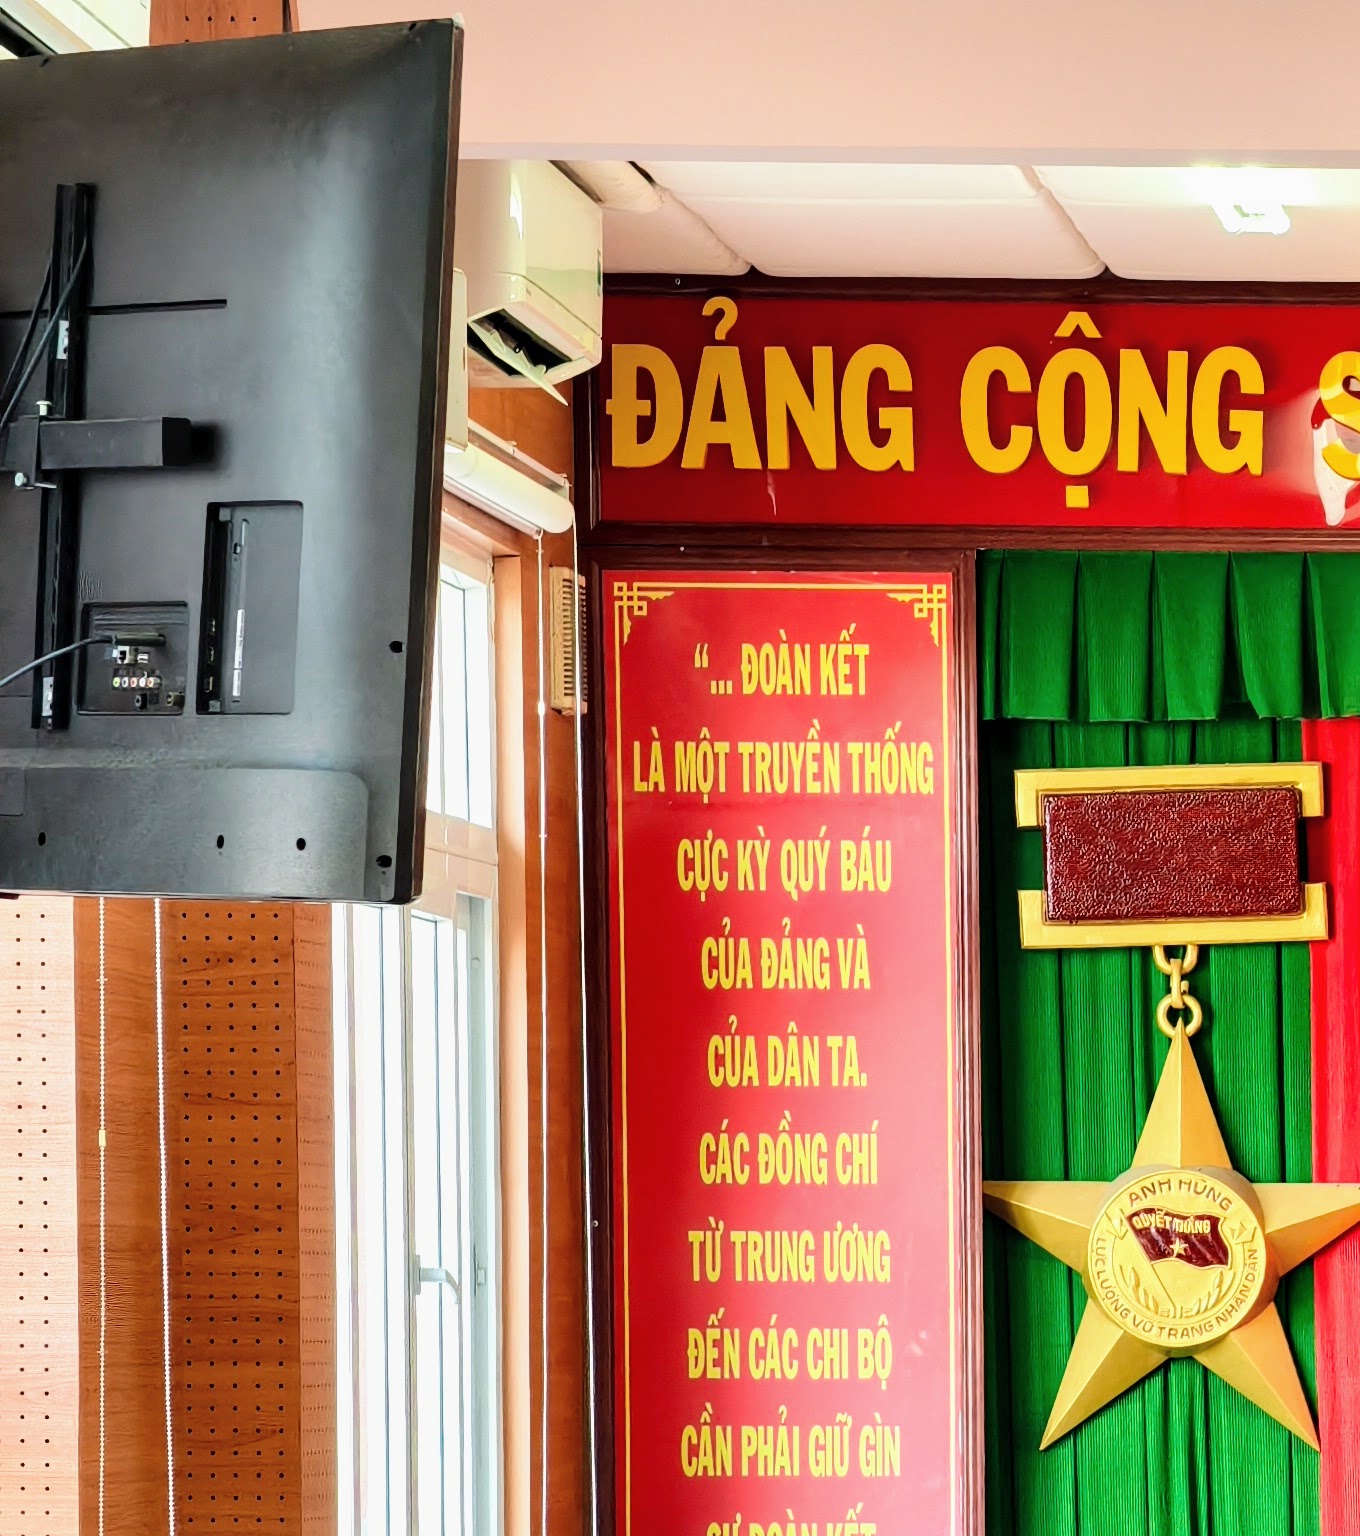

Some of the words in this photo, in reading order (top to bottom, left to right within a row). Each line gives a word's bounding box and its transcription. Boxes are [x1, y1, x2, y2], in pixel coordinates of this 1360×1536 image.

[606, 296, 915, 472] ĐẢNG
[960, 311, 1266, 509] CỘNG
[741, 628, 812, 697] ĐOÀN
[820, 622, 870, 697] KẾT
[633, 726, 666, 794] LÀ
[674, 726, 730, 804] MỘT
[738, 718, 840, 795] TRUYỀN
[848, 720, 935, 795] THỐNG
[677, 829, 728, 902] CỰC
[737, 825, 771, 891] KỲ
[780, 825, 829, 901] QUÝ
[840, 826, 892, 892] BÁU
[702, 916, 754, 990] CỦA
[760, 916, 831, 990] ĐẢNG
[838, 924, 871, 989] VÀ
[708, 1014, 760, 1088] CỦA
[768, 1022, 820, 1087] DÂN
[827, 1035, 868, 1087] TA.
[699, 1119, 750, 1185] CÁC
[757, 1110, 827, 1185] ĐỒNG
[836, 1119, 879, 1186] CHÍ
[1128, 1178, 1171, 1207] ANH
[1178, 1178, 1233, 1211] HÙNG
[688, 1216, 724, 1283] TỪ
[730, 1230, 815, 1283] TRUNG
[823, 1220, 891, 1283] ƯƠNG
[687, 1307, 740, 1380] ĐẾN
[748, 1315, 799, 1380] CÁC
[807, 1327, 849, 1380] CHI
[858, 1313, 893, 1390] BỘ
[681, 1404, 732, 1478] CẦN
[741, 1405, 800, 1477] PHẢI
[808, 1413, 851, 1478] GIỮ
[859, 1412, 901, 1477] GÌN
